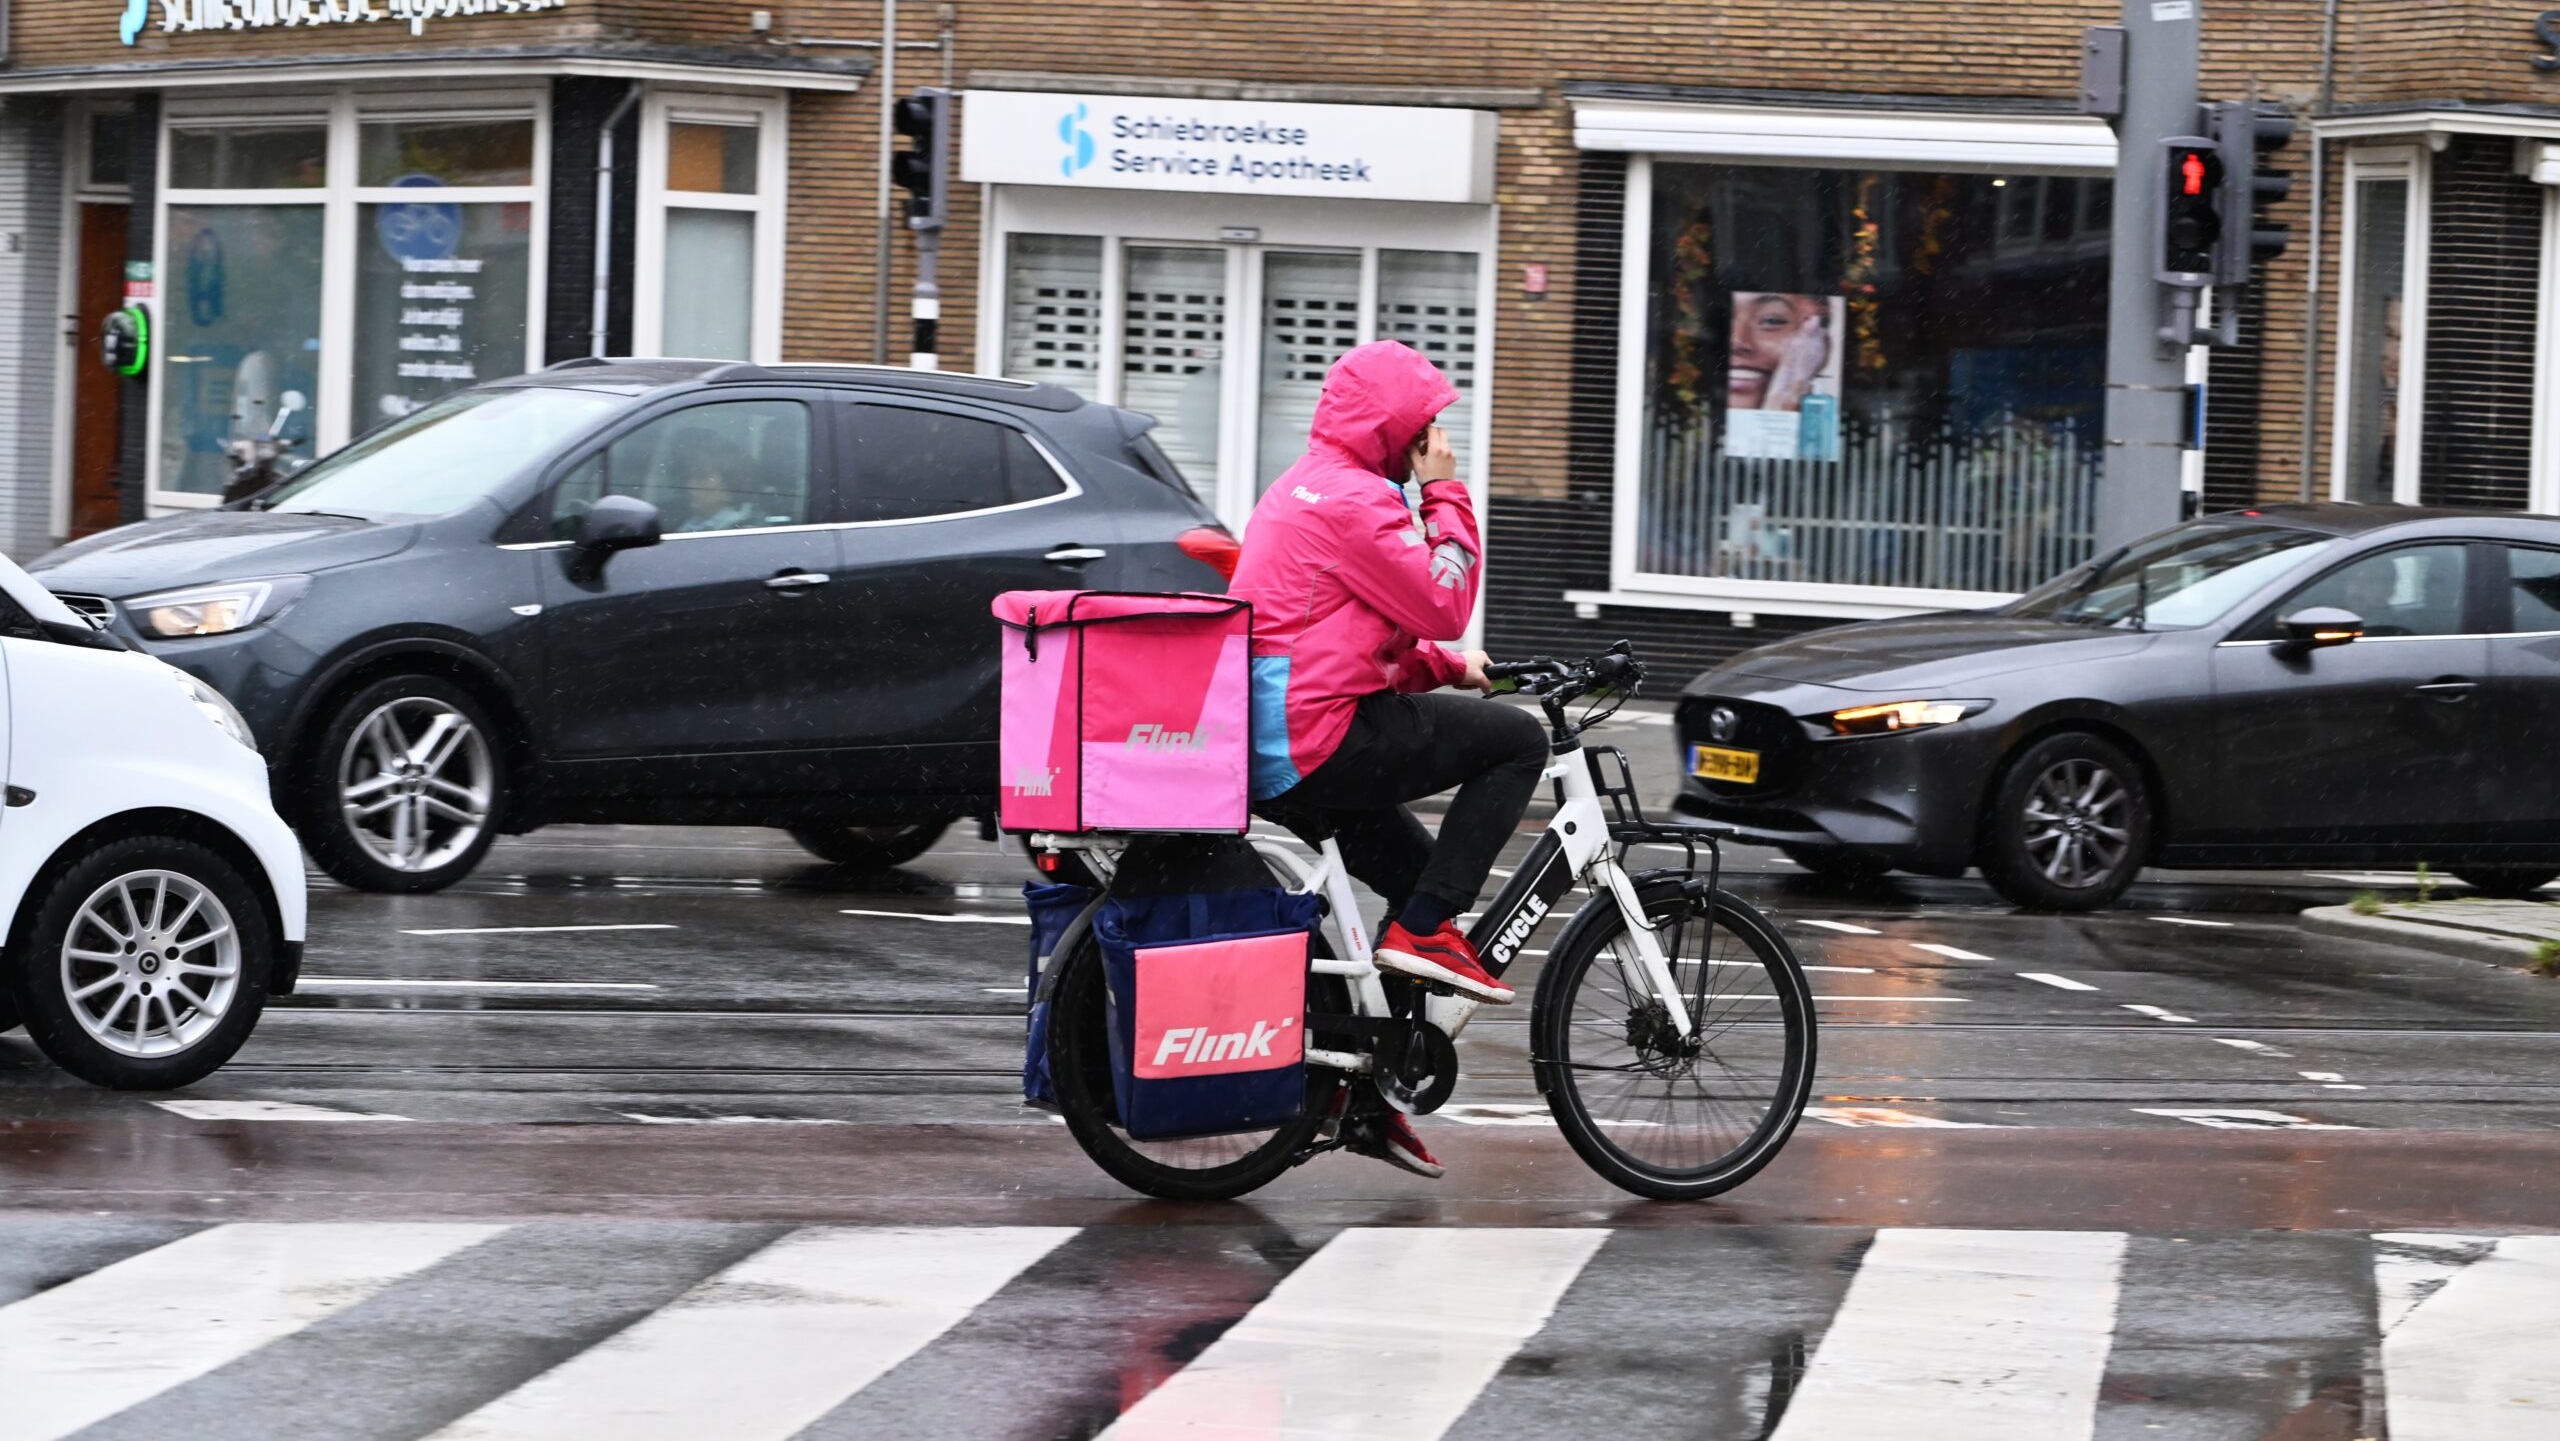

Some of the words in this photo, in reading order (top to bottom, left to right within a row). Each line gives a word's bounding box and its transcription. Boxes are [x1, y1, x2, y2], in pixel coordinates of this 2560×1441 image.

[1112, 115, 1308, 145] Schiebroekse
[1110, 149, 1219, 176] Service
[1226, 153, 1372, 183] Apotheek
[1123, 723, 1216, 754] Flink
[1013, 767, 1056, 797] Flink
[1491, 893, 1549, 964] CYCLE
[1151, 1018, 1285, 1066] Flink
